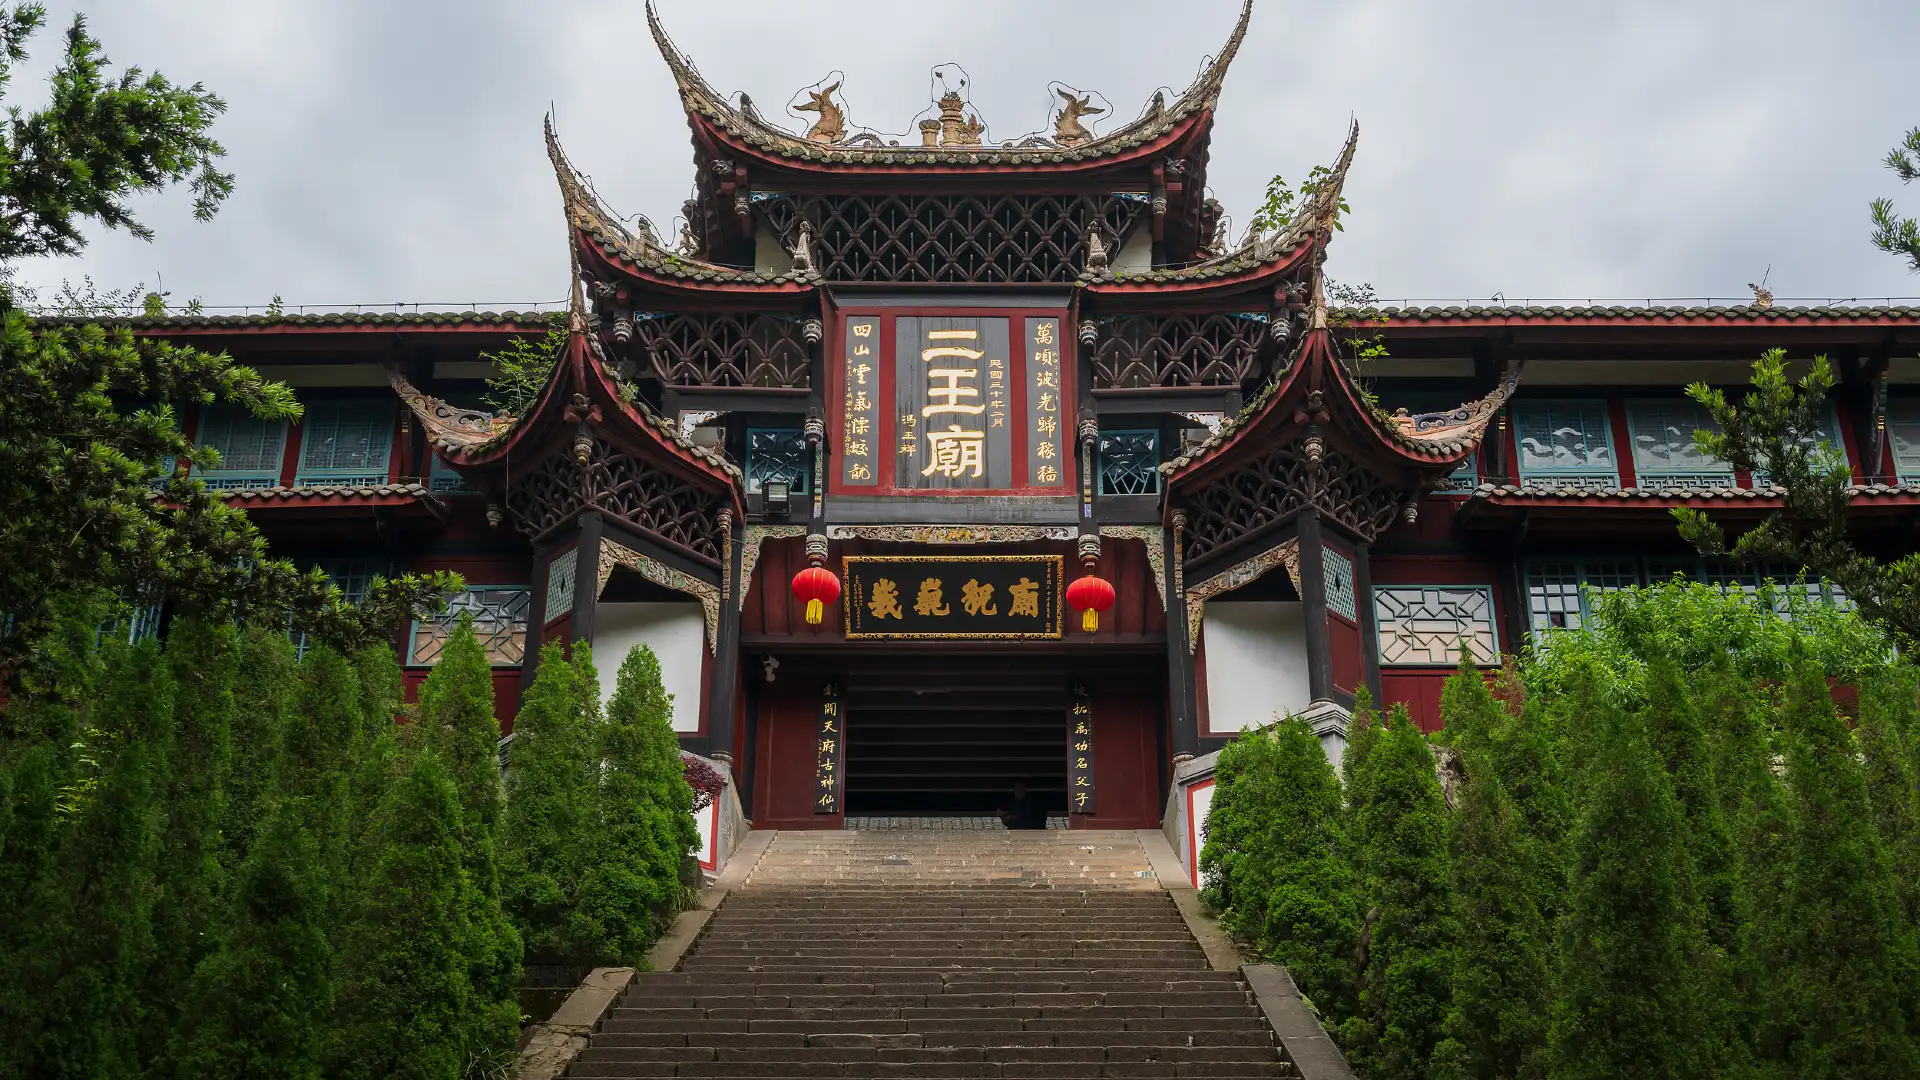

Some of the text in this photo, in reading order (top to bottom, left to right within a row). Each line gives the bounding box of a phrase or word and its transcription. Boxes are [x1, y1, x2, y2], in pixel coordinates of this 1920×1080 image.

[921, 330, 985, 478] 二王廟
[1034, 322, 1058, 483] 萬頃波光歸稼穡
